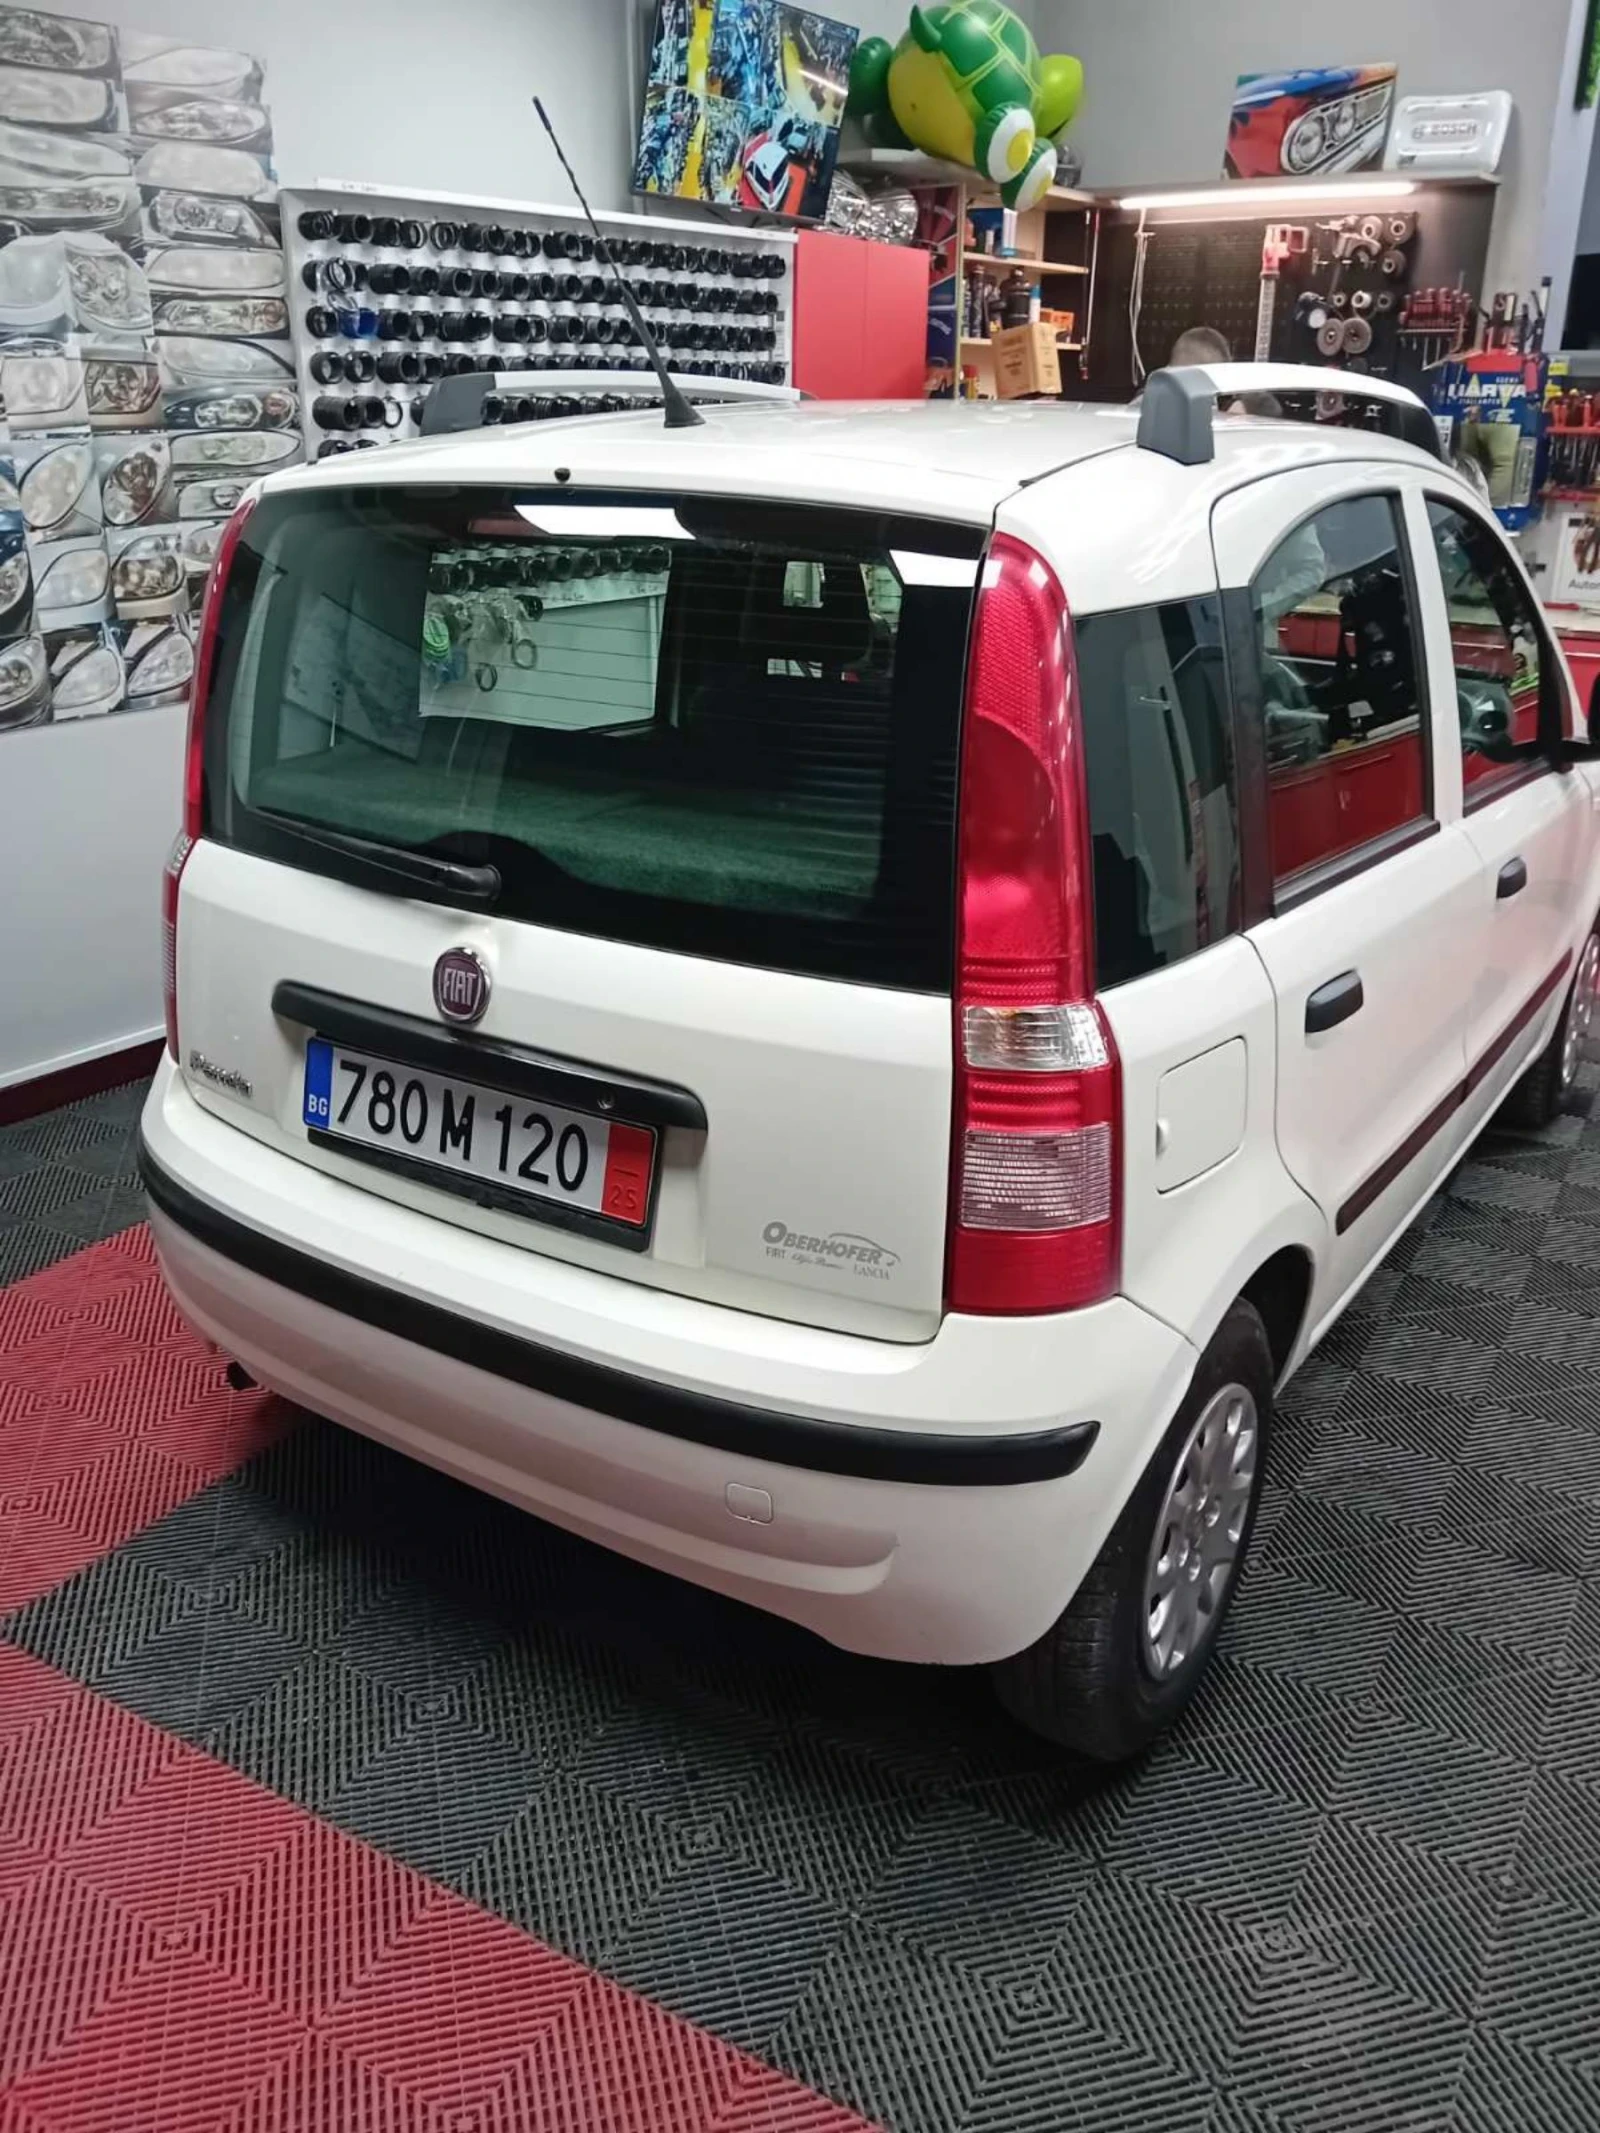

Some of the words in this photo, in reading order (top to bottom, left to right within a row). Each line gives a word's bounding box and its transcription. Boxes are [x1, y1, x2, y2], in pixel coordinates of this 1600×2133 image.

[1430, 122, 1478, 136] BOSCH
[443, 967, 477, 1006] FIAT
[308, 1094, 328, 1117] BG
[337, 1059, 429, 1144] 780
[439, 1088, 476, 1162] M
[495, 1104, 589, 1192] 120
[610, 1183, 638, 1210] 25
